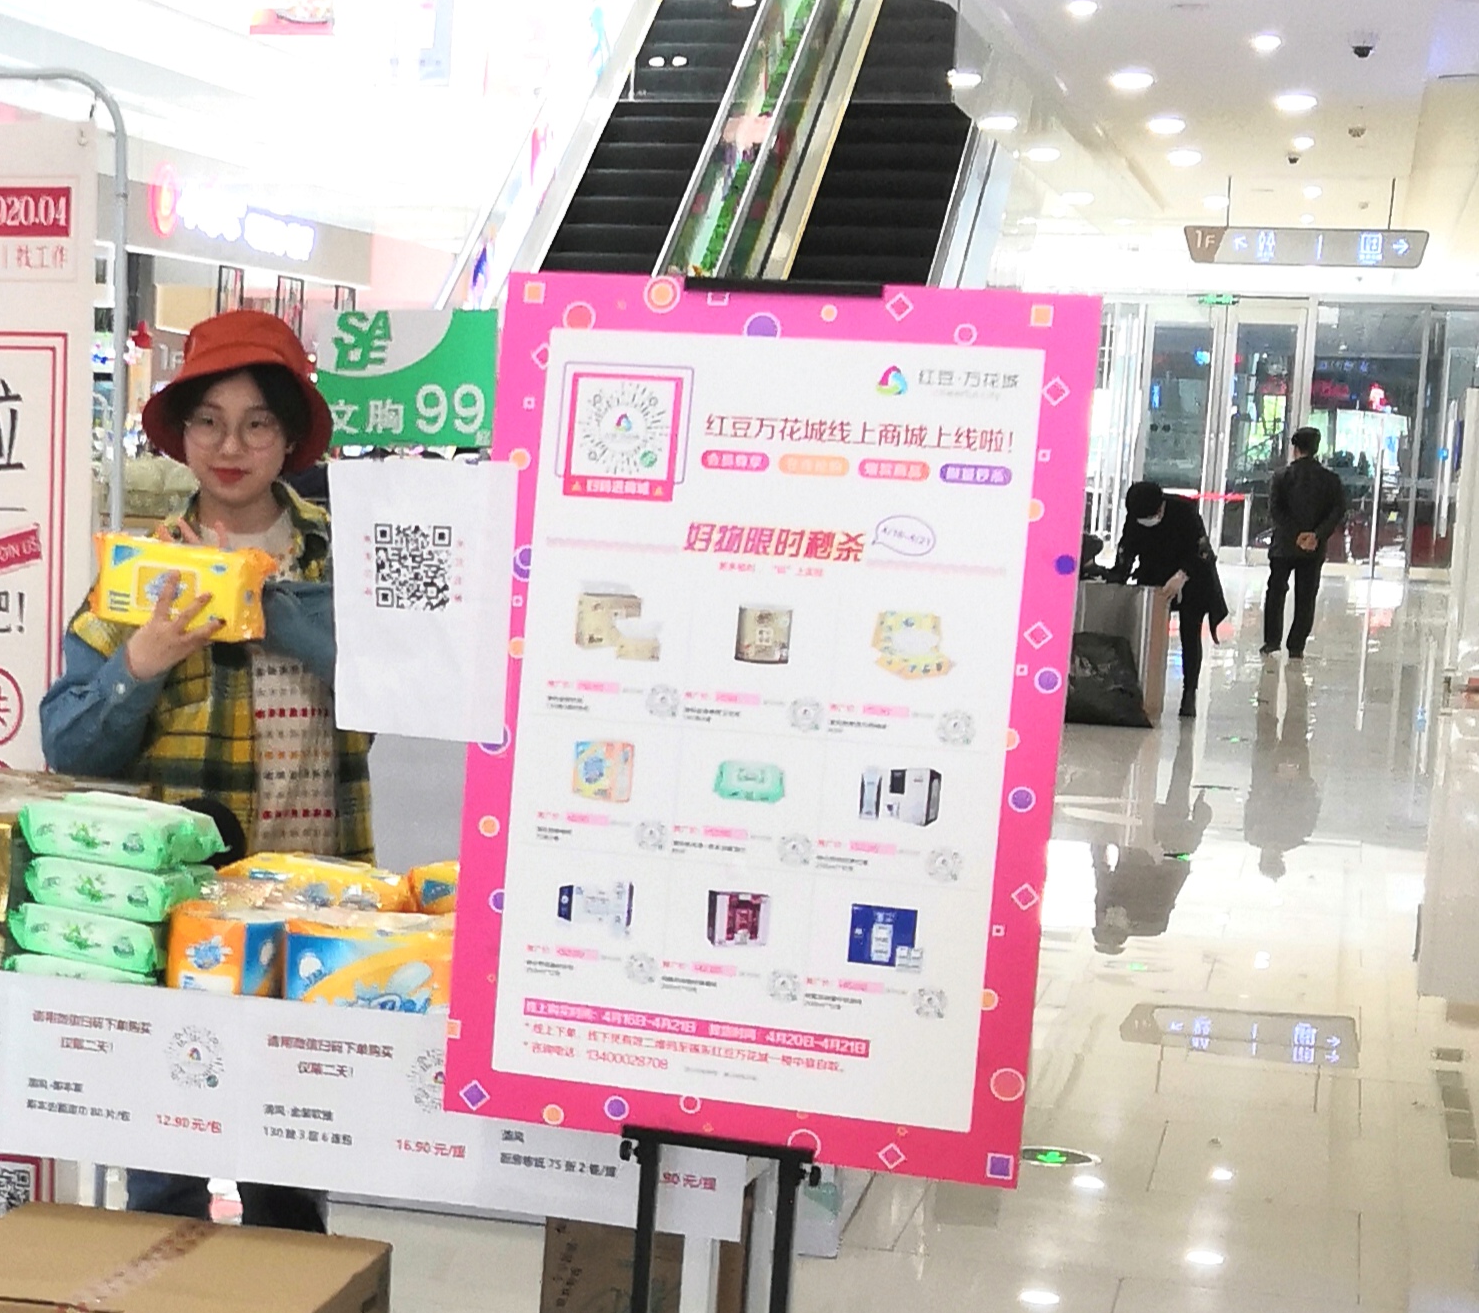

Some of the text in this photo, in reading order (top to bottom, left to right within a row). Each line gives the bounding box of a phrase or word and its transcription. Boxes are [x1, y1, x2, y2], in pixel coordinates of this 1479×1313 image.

[1195, 229, 1216, 249] 1F
[328, 384, 485, 435] 文胸 99
[683, 521, 866, 563] 好物限时秒杀
